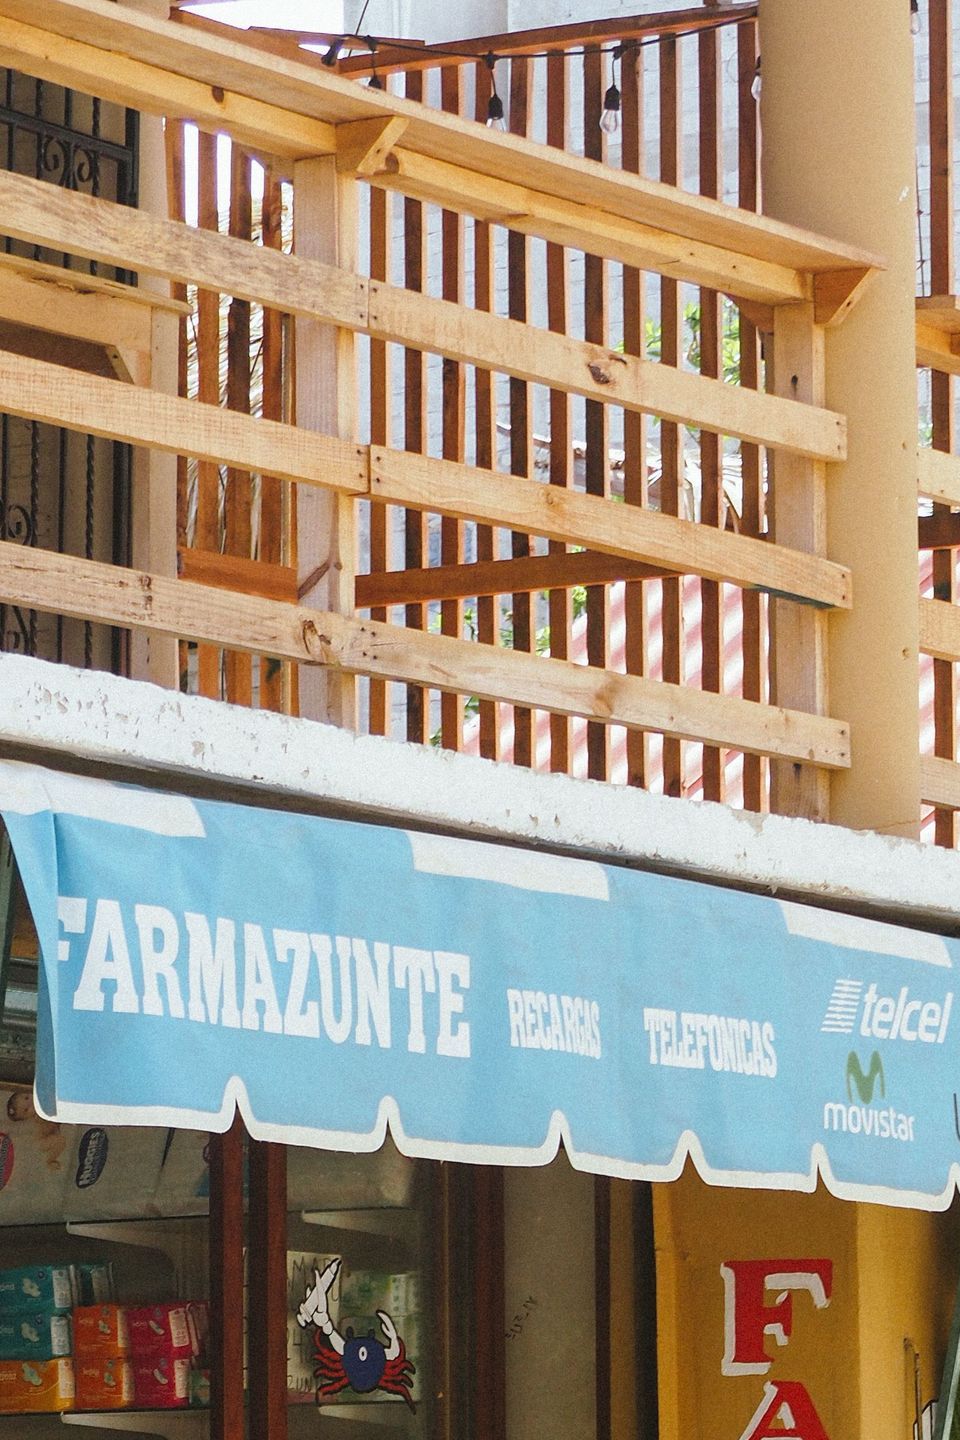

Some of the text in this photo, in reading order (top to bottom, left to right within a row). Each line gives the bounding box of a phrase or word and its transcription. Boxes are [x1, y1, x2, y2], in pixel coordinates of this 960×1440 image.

[57, 896, 471, 1058] FARMAZUNTE
[507, 988, 777, 1078] RECARGAS TELEFONICAS
[860, 983, 953, 1044] telcel
[824, 1102, 915, 1142] movistar
[78, 1131, 102, 1186] HUGGIES
